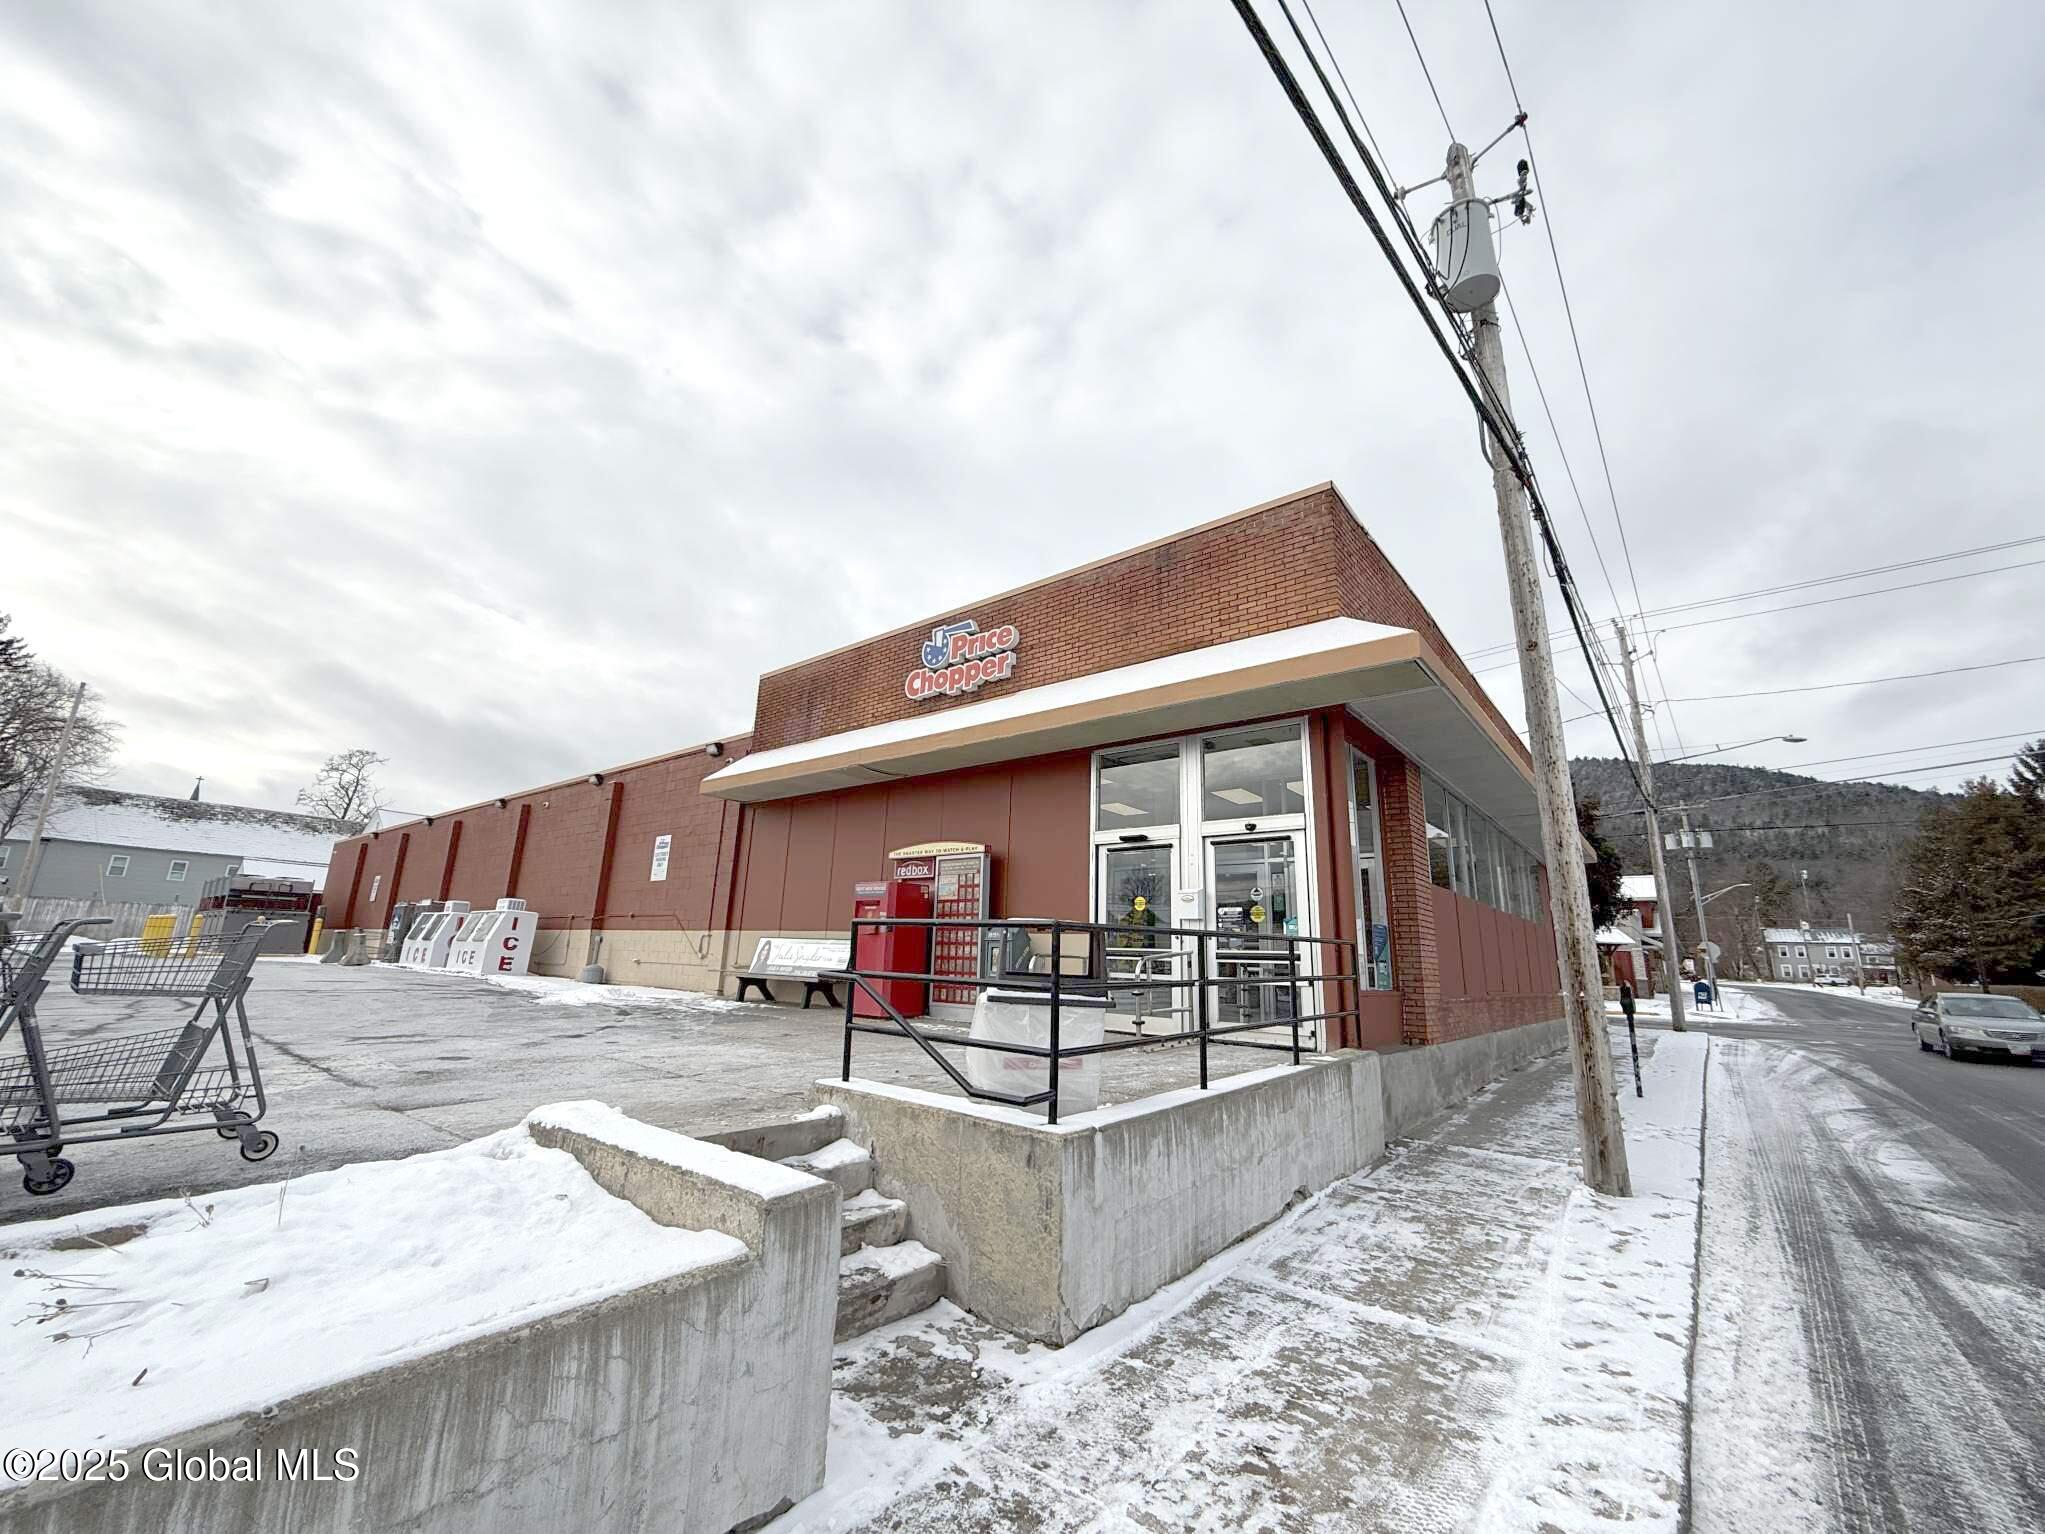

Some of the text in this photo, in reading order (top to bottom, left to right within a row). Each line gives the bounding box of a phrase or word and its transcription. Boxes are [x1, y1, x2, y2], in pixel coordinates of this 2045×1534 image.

[950, 625, 1014, 662] Price
[905, 651, 1011, 698] Chopper
[897, 865, 929, 876] redbox
[405, 946, 428, 963] ICE
[456, 950, 476, 965] ICE
[498, 917, 519, 971] ICE
